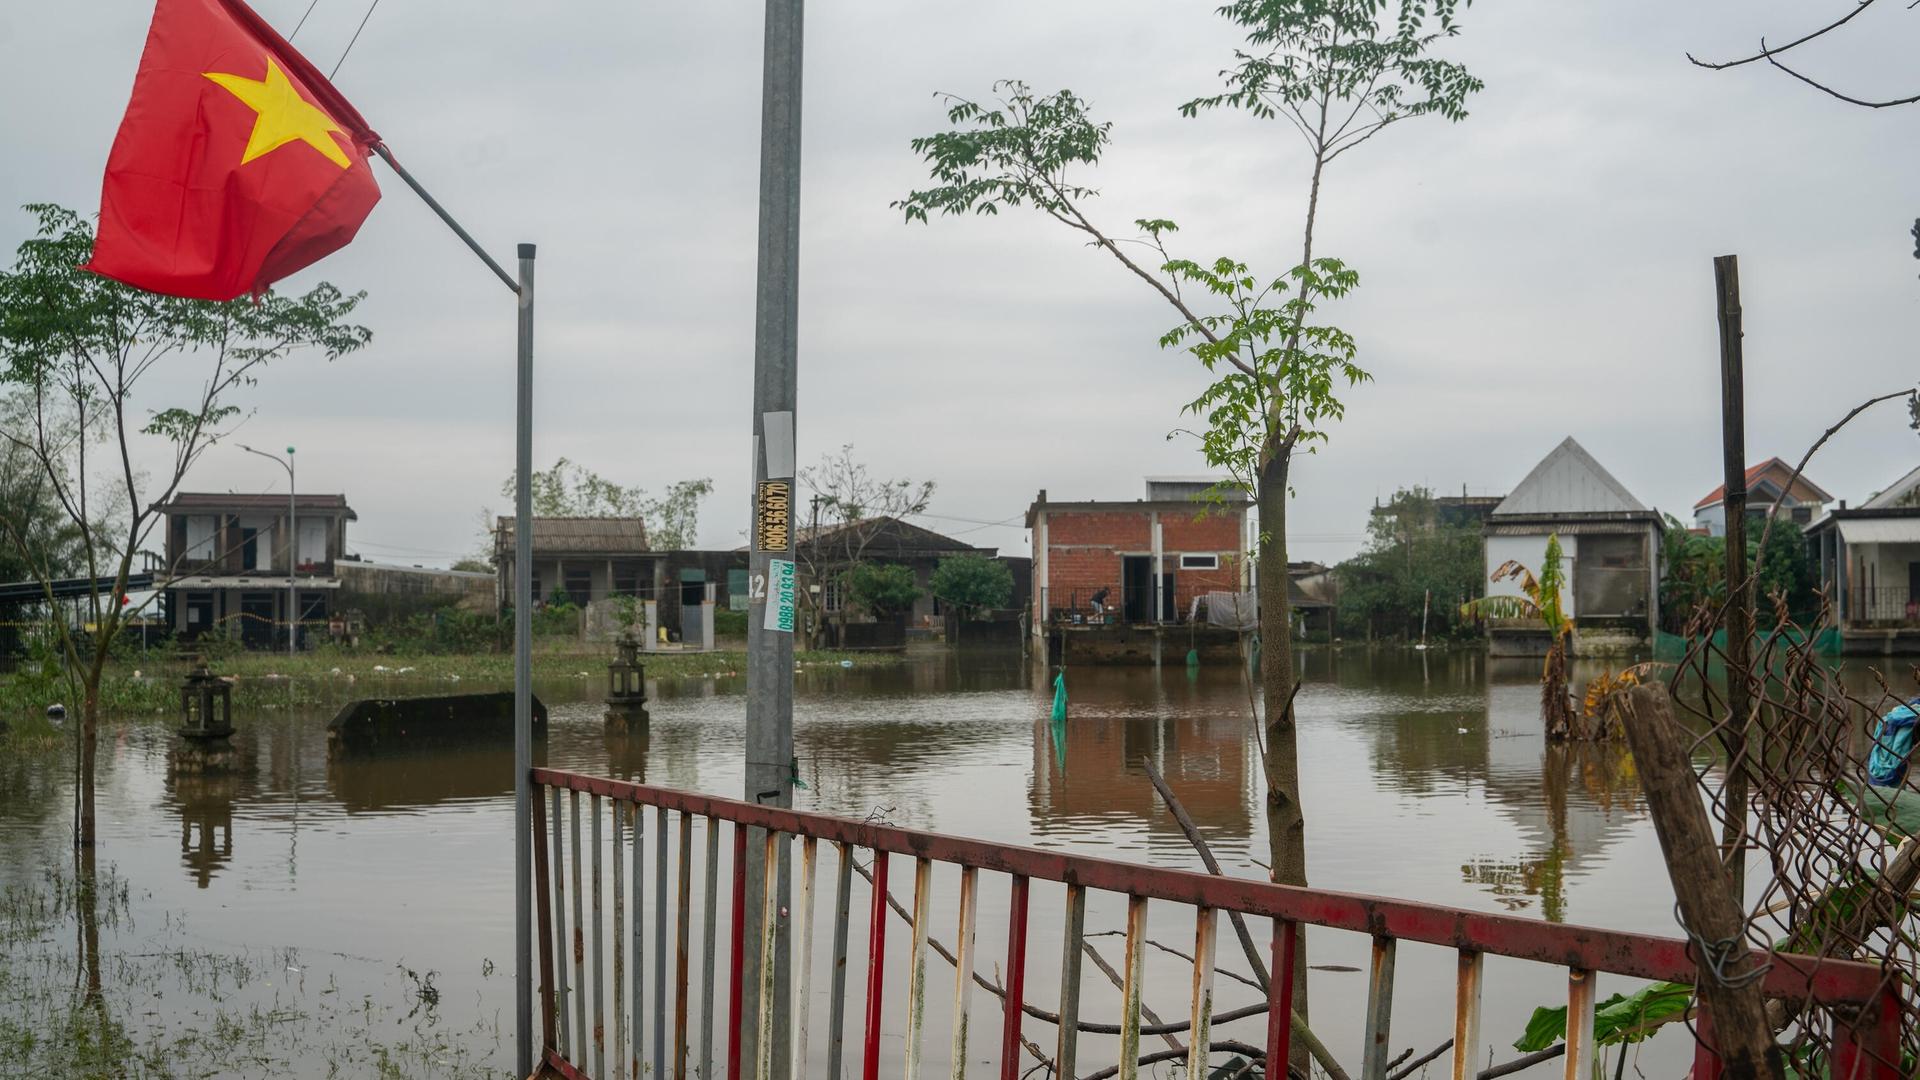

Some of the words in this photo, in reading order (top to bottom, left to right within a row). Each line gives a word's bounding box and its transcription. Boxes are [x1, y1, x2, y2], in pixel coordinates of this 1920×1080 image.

[765, 483, 788, 550] 0906.56.60.70
[782, 562, 794, 576] 94
[781, 577, 794, 589] 93
[779, 591, 794, 604] 20
[776, 605, 793, 630] 0988
